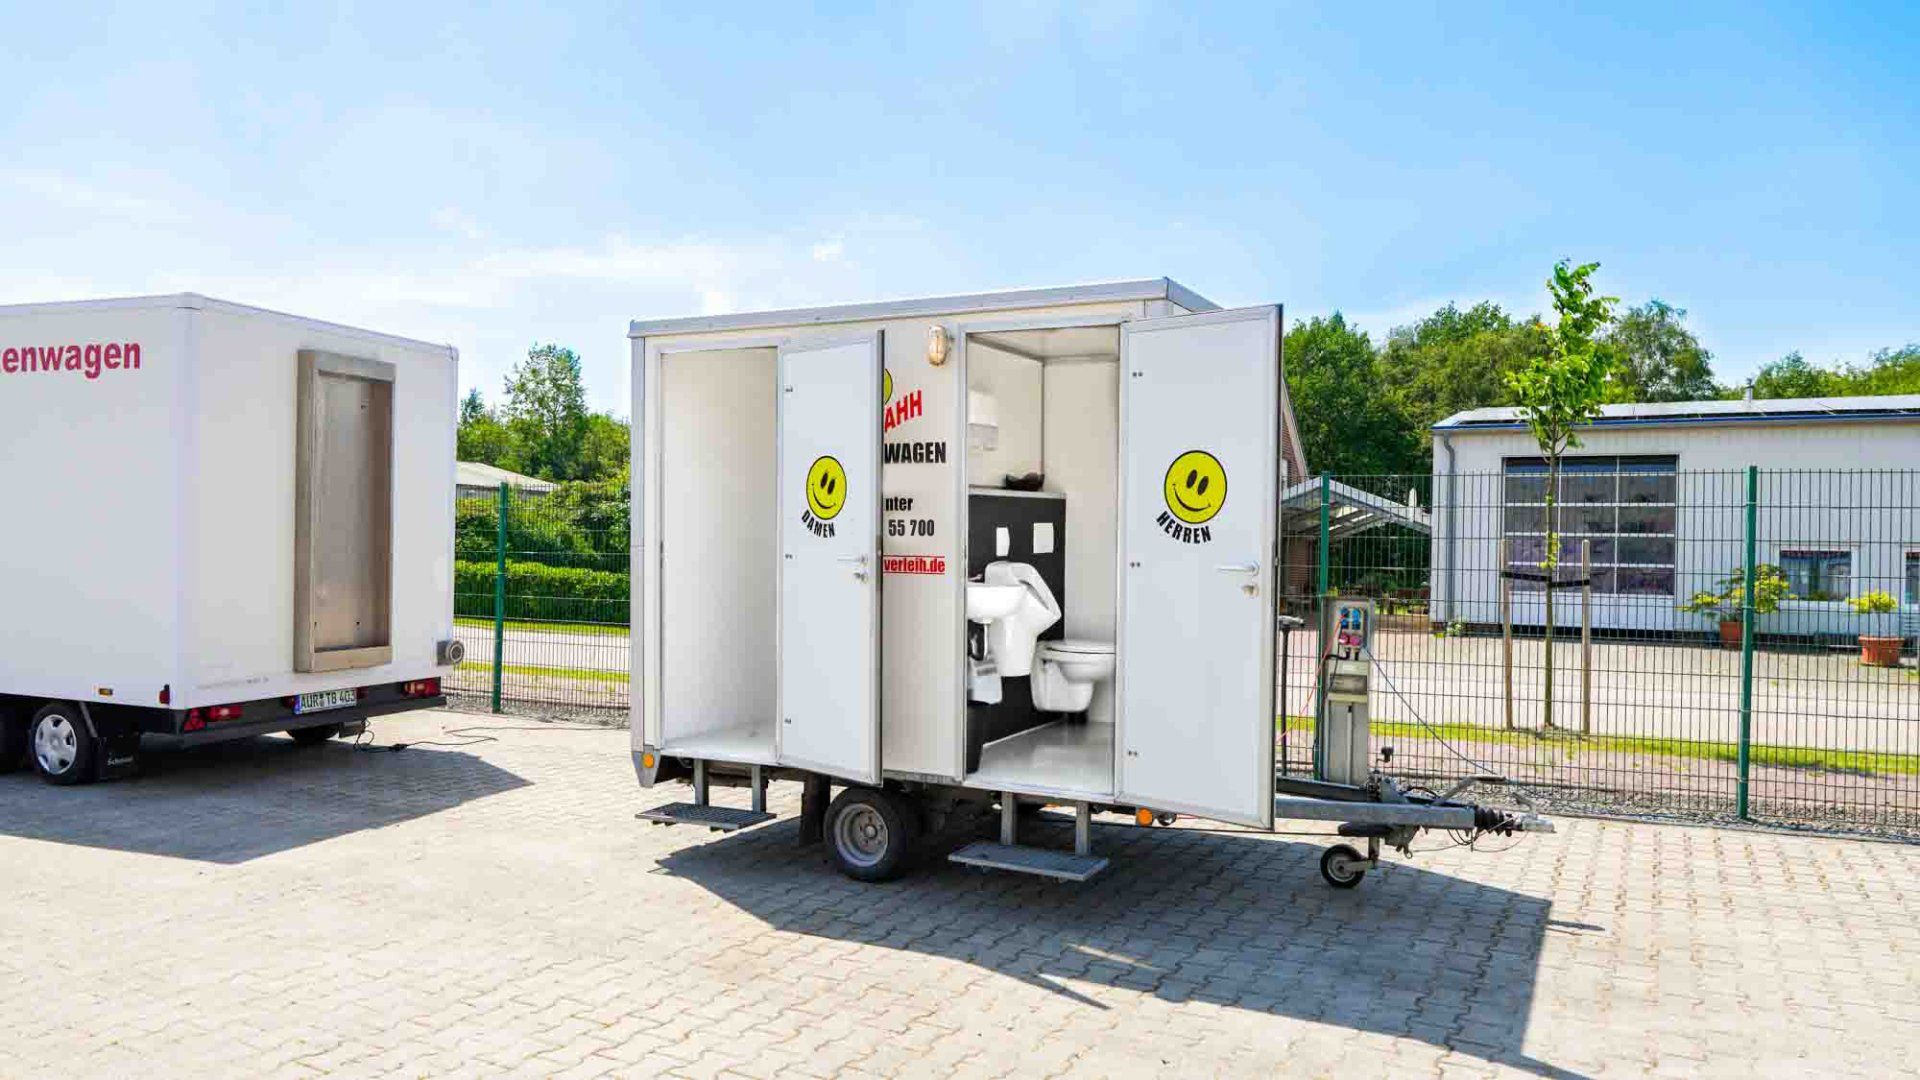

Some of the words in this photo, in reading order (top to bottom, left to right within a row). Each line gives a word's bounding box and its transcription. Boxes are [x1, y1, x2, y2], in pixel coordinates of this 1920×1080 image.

[2, 342, 140, 379] enwagen
[884, 389, 922, 433] AHH
[884, 441, 946, 464] WAGEN
[801, 509, 835, 538] DAMEN
[888, 519, 905, 537] 55
[909, 519, 935, 537] 700
[1156, 510, 1211, 544] HERREN
[884, 557, 945, 573] verleih.de
